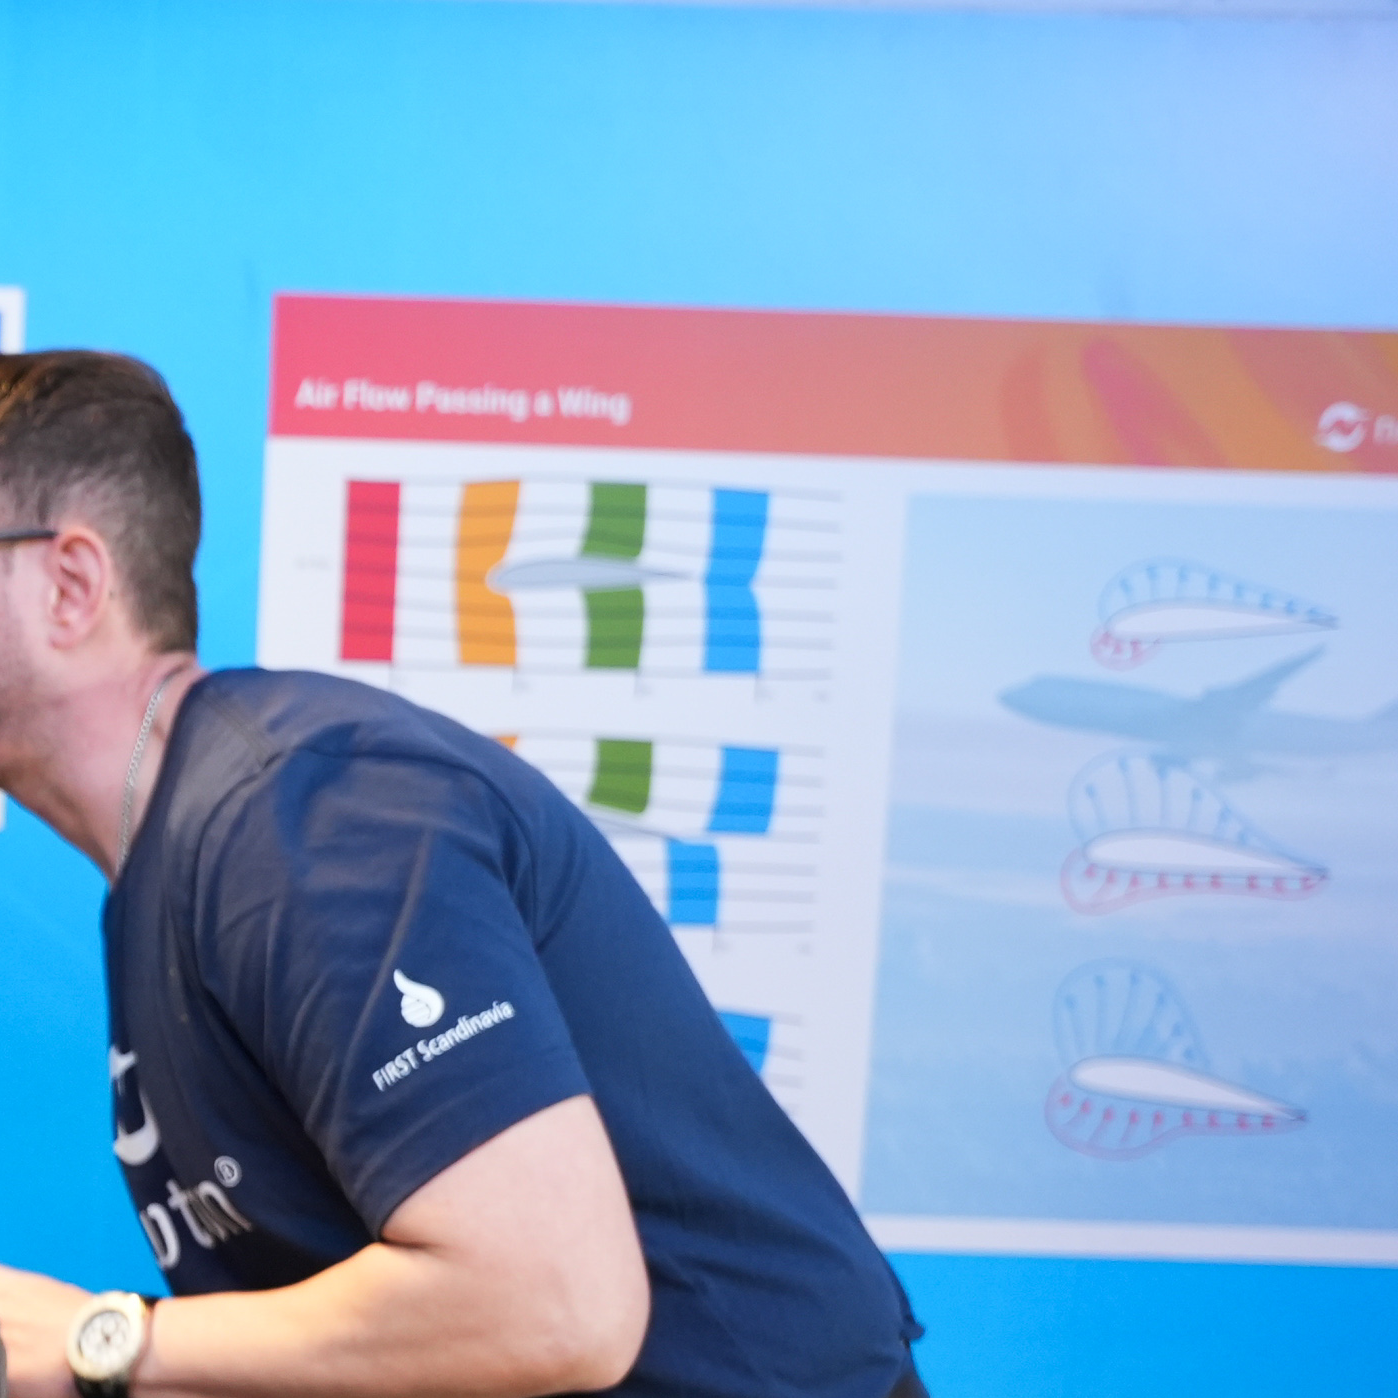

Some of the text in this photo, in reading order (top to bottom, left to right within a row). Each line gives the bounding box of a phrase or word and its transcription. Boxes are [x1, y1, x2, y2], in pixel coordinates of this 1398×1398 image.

[294, 376, 633, 426] Air Flow Passing a Wing
[372, 1000, 516, 1092] FIRST Scandinavia
